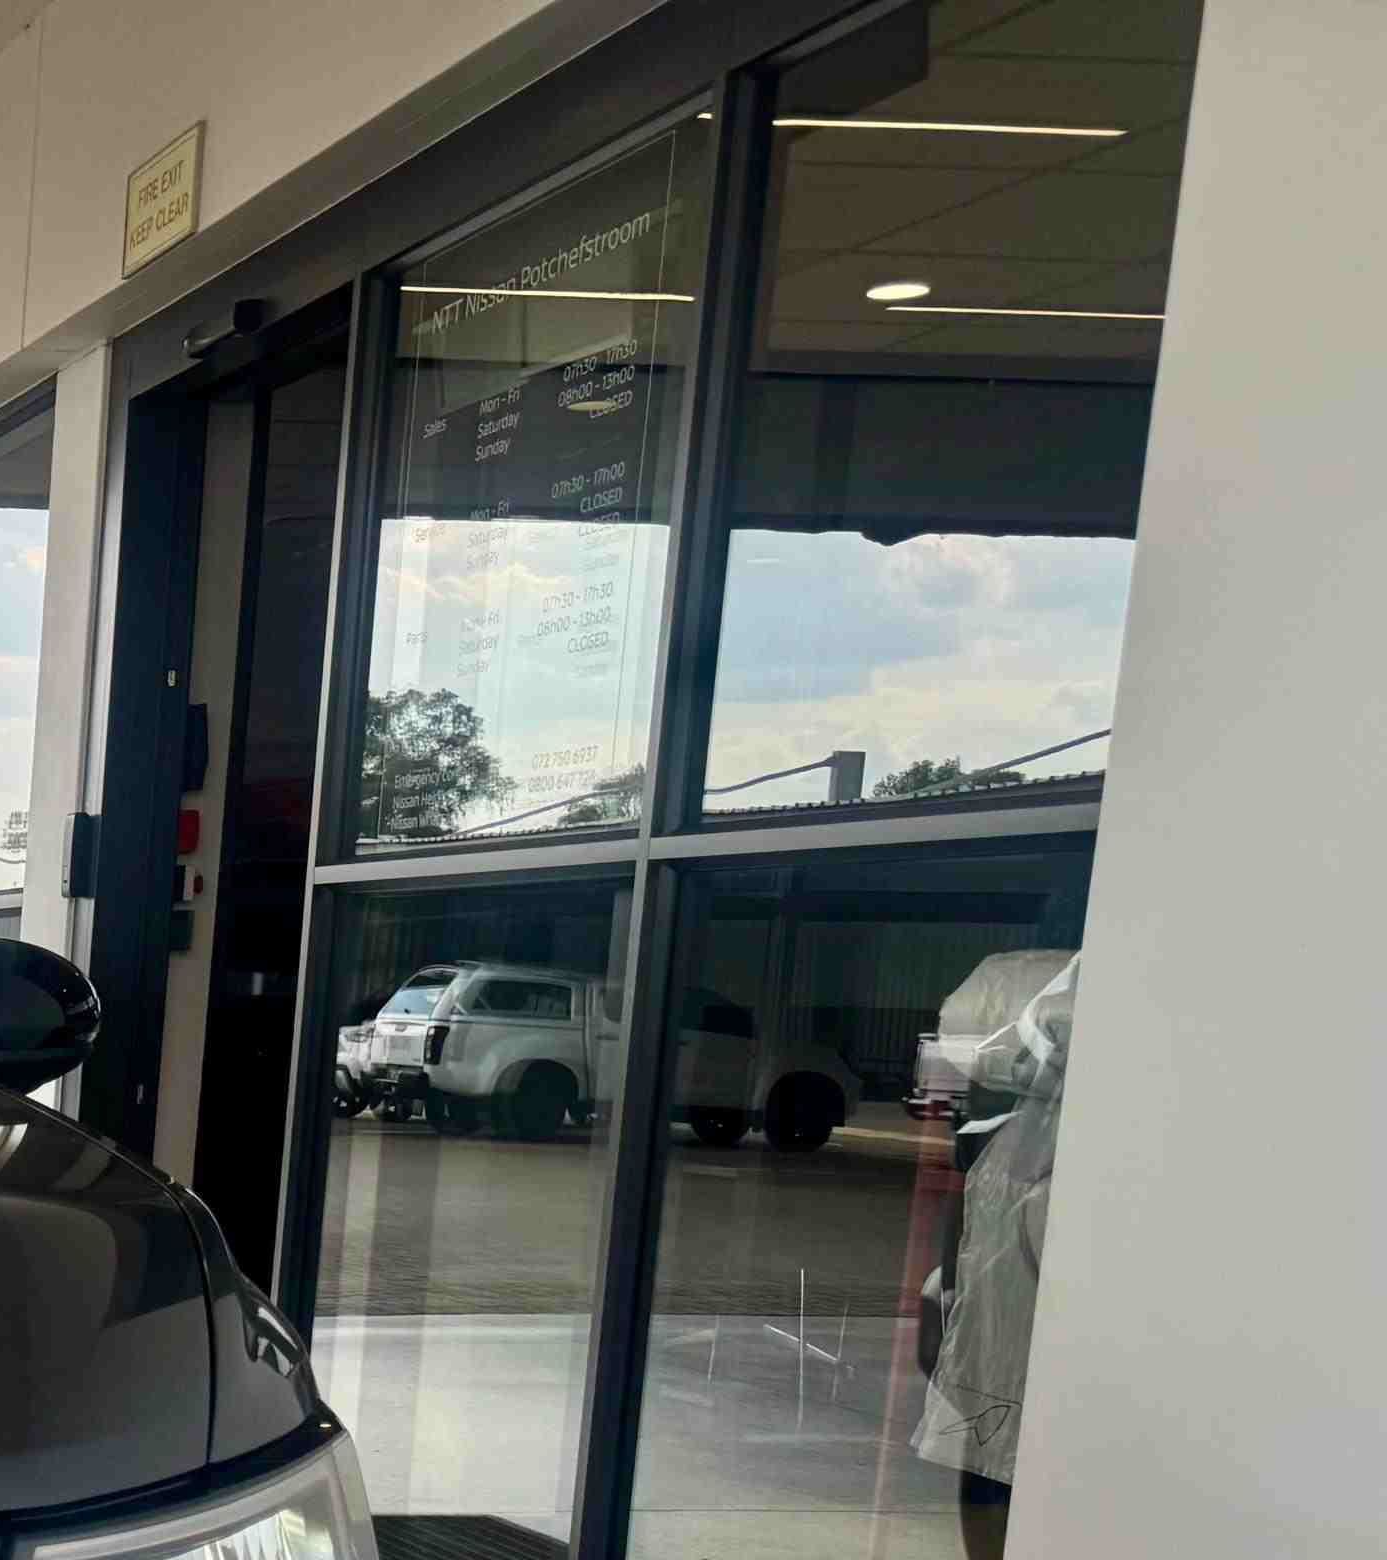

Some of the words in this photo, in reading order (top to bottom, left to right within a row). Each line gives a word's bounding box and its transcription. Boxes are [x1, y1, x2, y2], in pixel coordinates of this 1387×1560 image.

[138, 178, 159, 208] FIRE
[161, 159, 184, 193] EXIT
[129, 216, 154, 251] KEEP
[155, 191, 189, 232] CLEAR
[432, 298, 464, 334] NTT
[465, 277, 516, 319] Nissan
[520, 212, 651, 290] Potchefstroom
[479, 398, 500, 416] Mon
[423, 418, 447, 438] Sales
[477, 410, 521, 438] Saturday
[475, 437, 511, 462] Sunday
[551, 474, 584, 498] 07h30
[593, 461, 626, 485] 17h00
[580, 486, 623, 513] CLOSED
